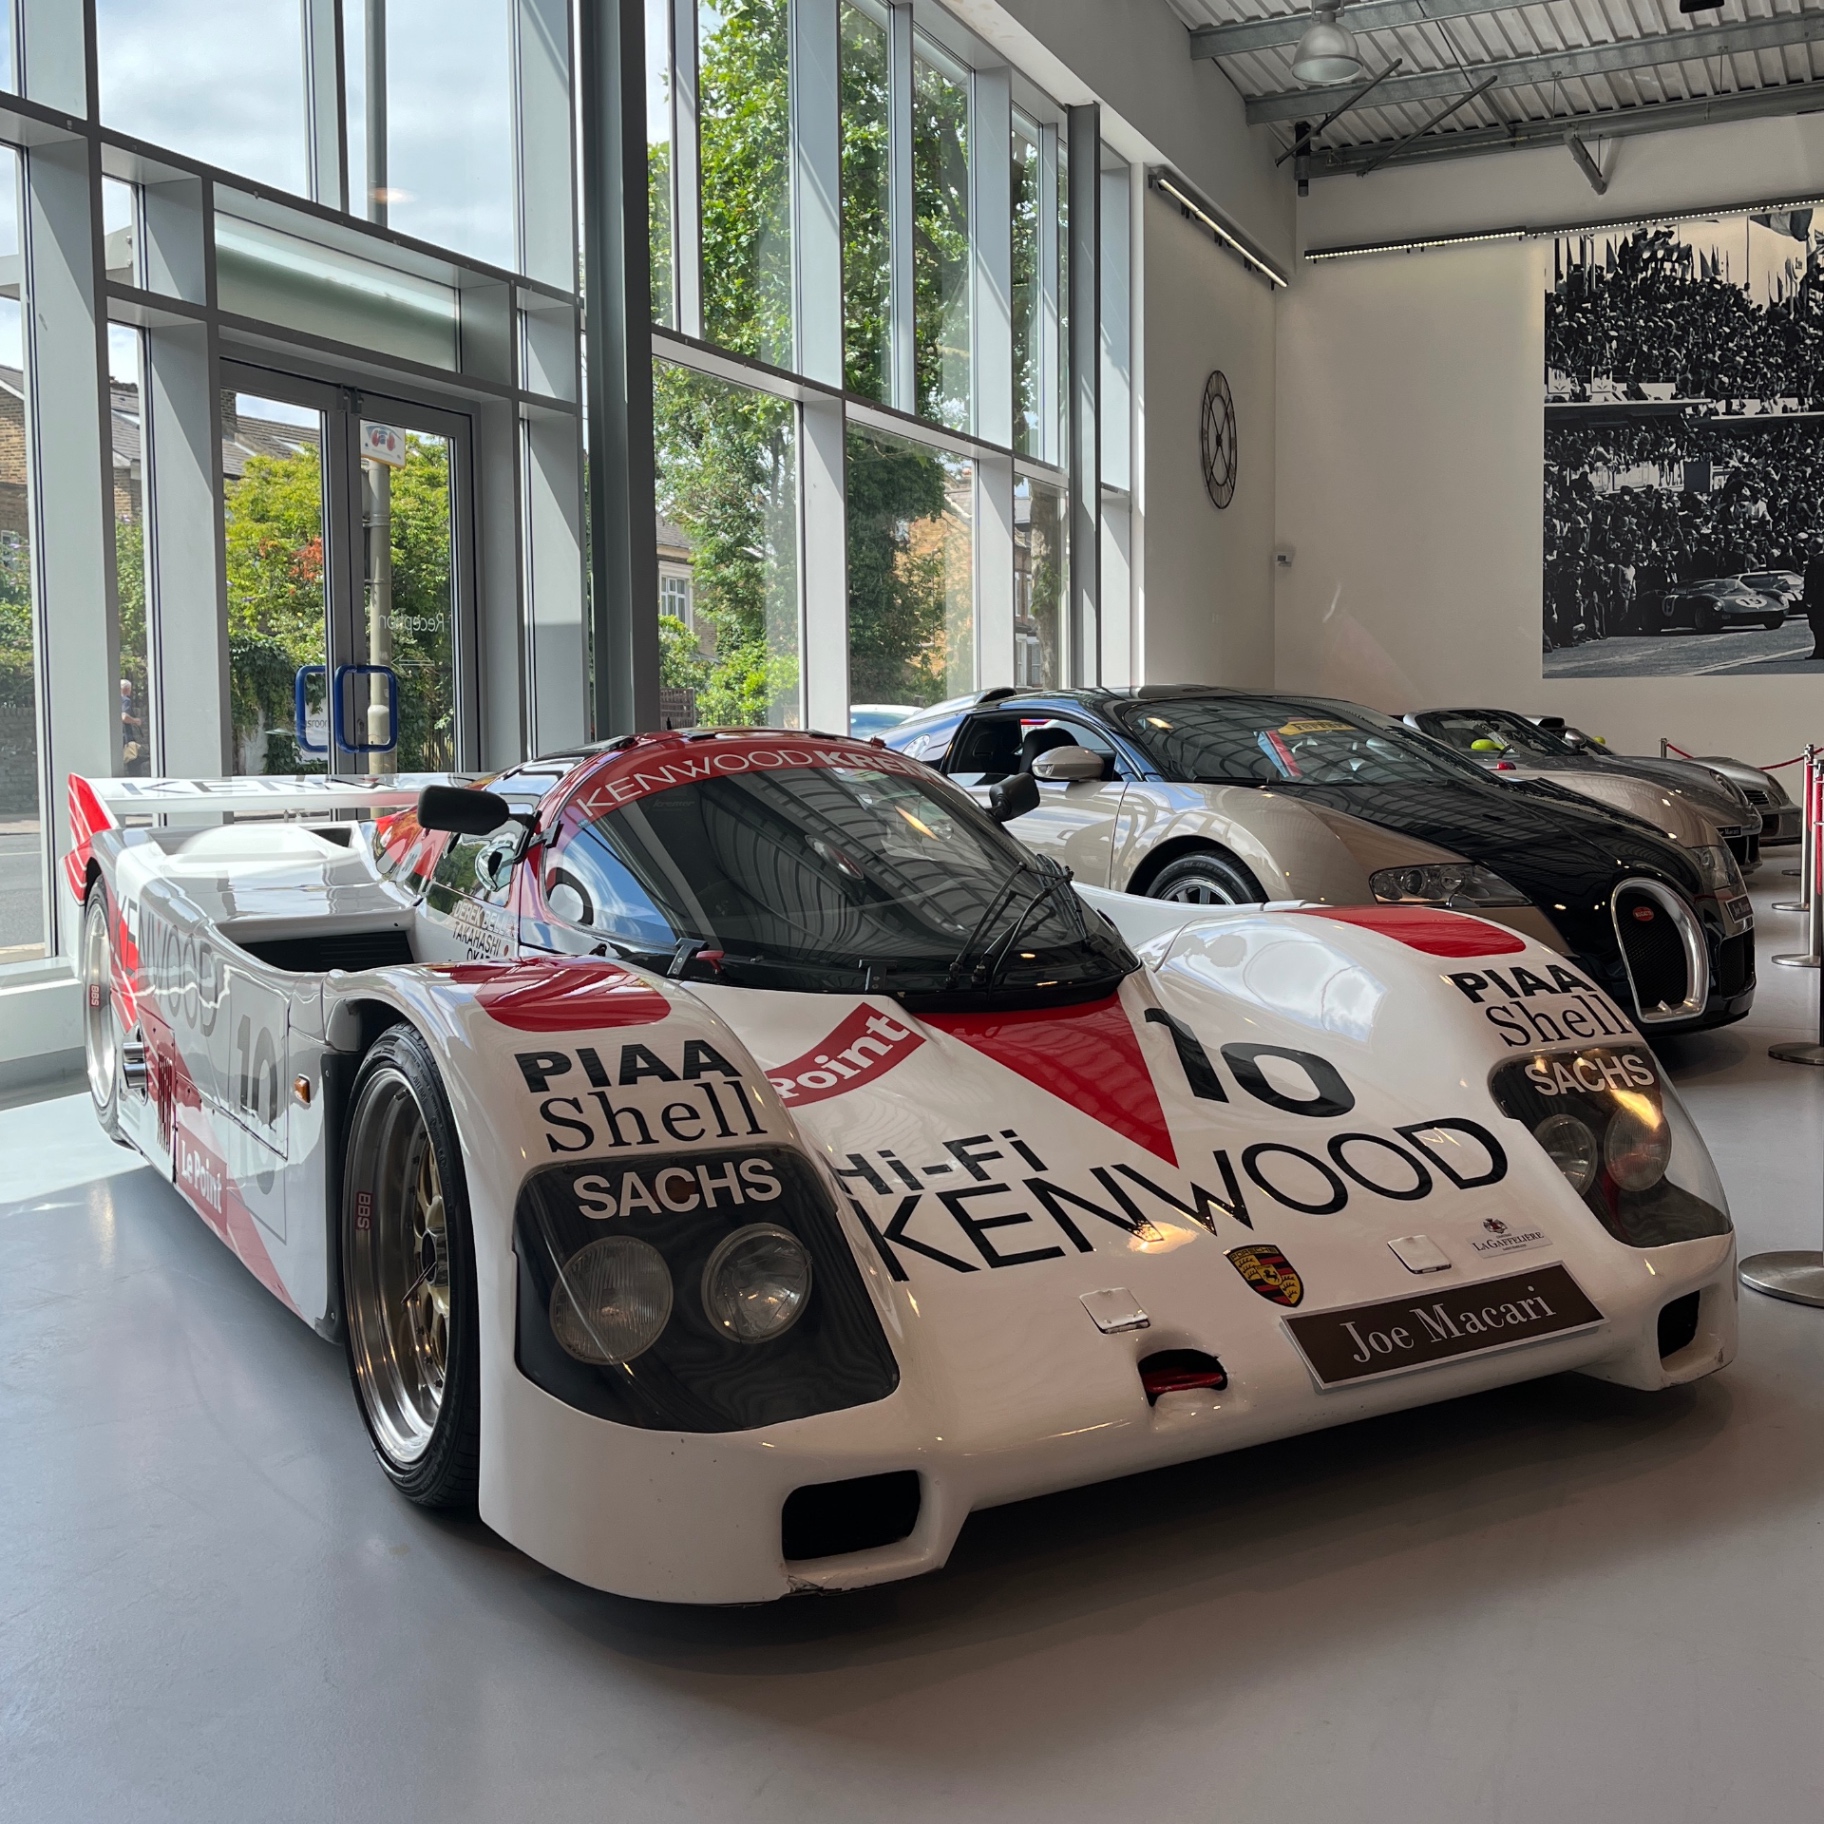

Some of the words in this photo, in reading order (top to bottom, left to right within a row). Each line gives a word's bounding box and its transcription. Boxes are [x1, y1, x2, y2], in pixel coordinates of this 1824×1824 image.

[576, 749, 813, 818] KENWOOD
[453, 900, 484, 928] DEREK
[453, 921, 501, 957] TAKAHASHI
[90, 984, 100, 1007] BBS
[1447, 964, 1597, 1004] PIAA
[1486, 994, 1633, 1048] Shell
[514, 1039, 744, 1094] PIAA
[1144, 1007, 1356, 1118] 10
[1524, 1054, 1655, 1097] SACHS
[539, 1080, 768, 1153] Shell
[181, 1140, 194, 1184] Le
[193, 1150, 223, 1214] Point
[573, 1158, 782, 1220] SACHS
[852, 1117, 1508, 1282] KENWOOD
[357, 1192, 372, 1231] BBS
[1340, 1320, 1415, 1363] Joe
[1409, 1285, 1558, 1344] Macari
